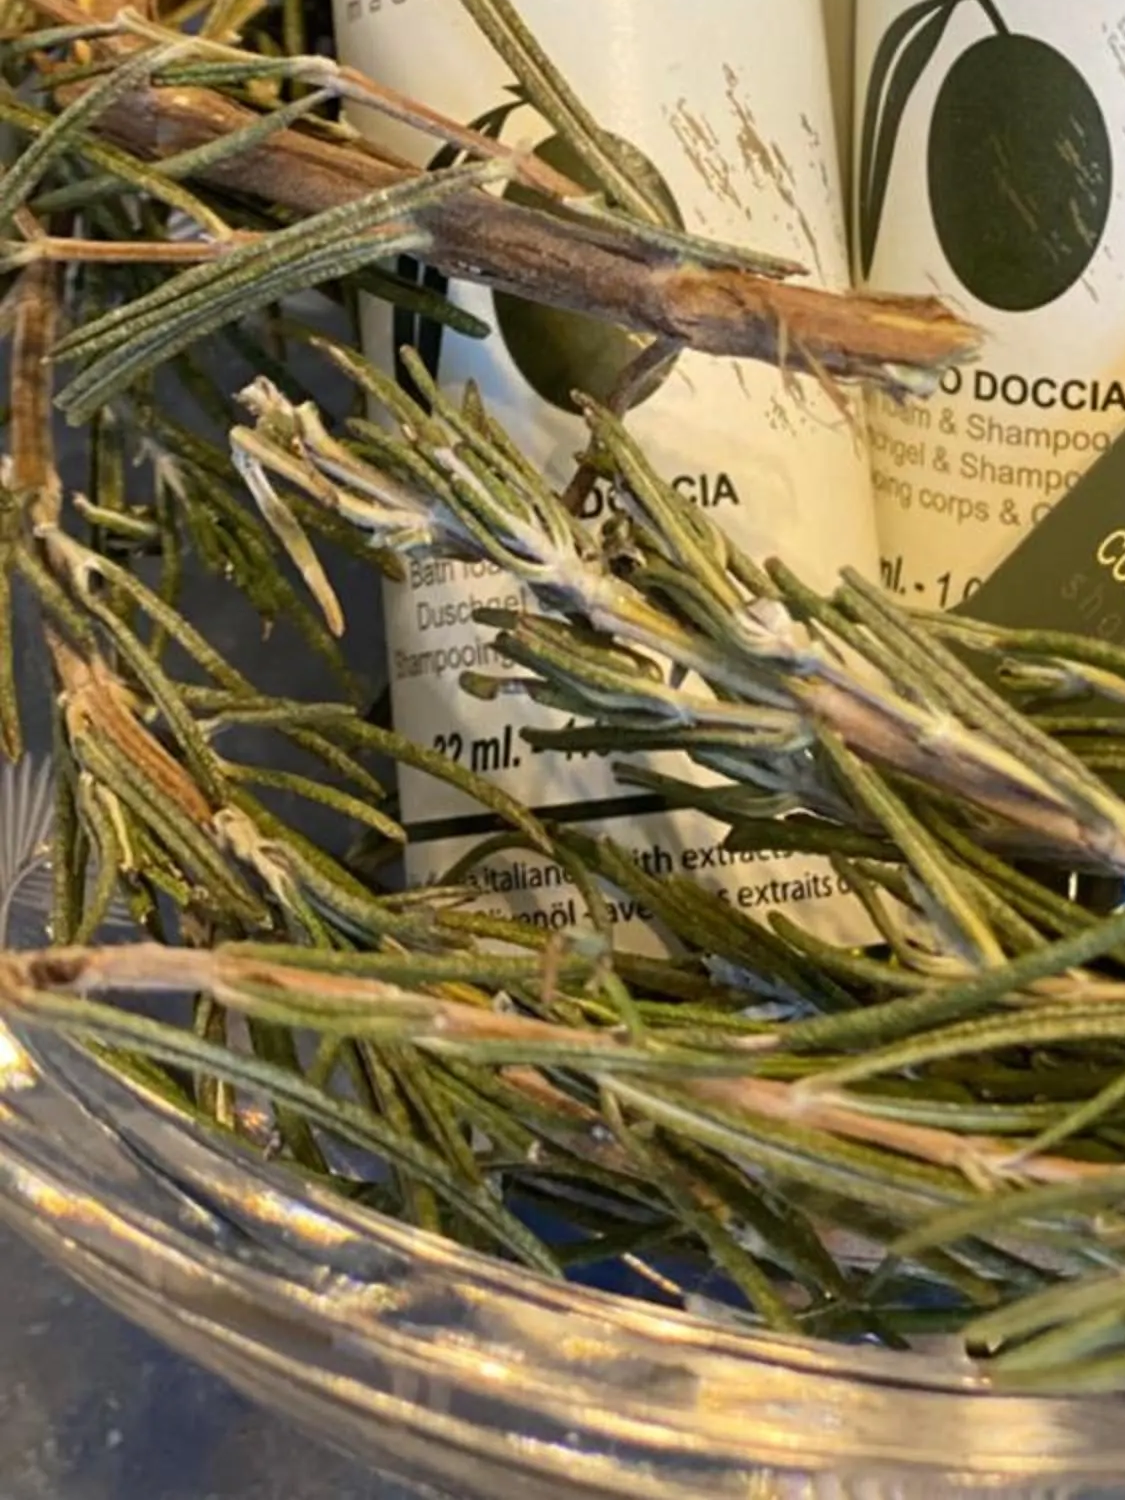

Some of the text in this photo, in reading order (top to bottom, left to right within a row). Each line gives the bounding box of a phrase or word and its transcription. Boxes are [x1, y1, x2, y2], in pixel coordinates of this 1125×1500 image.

[966, 413, 1111, 455] Shampoo
[960, 451, 1081, 495] Shampo
[919, 486, 990, 526] corps
[471, 724, 520, 773] ml.
[737, 871, 834, 907] extraits
